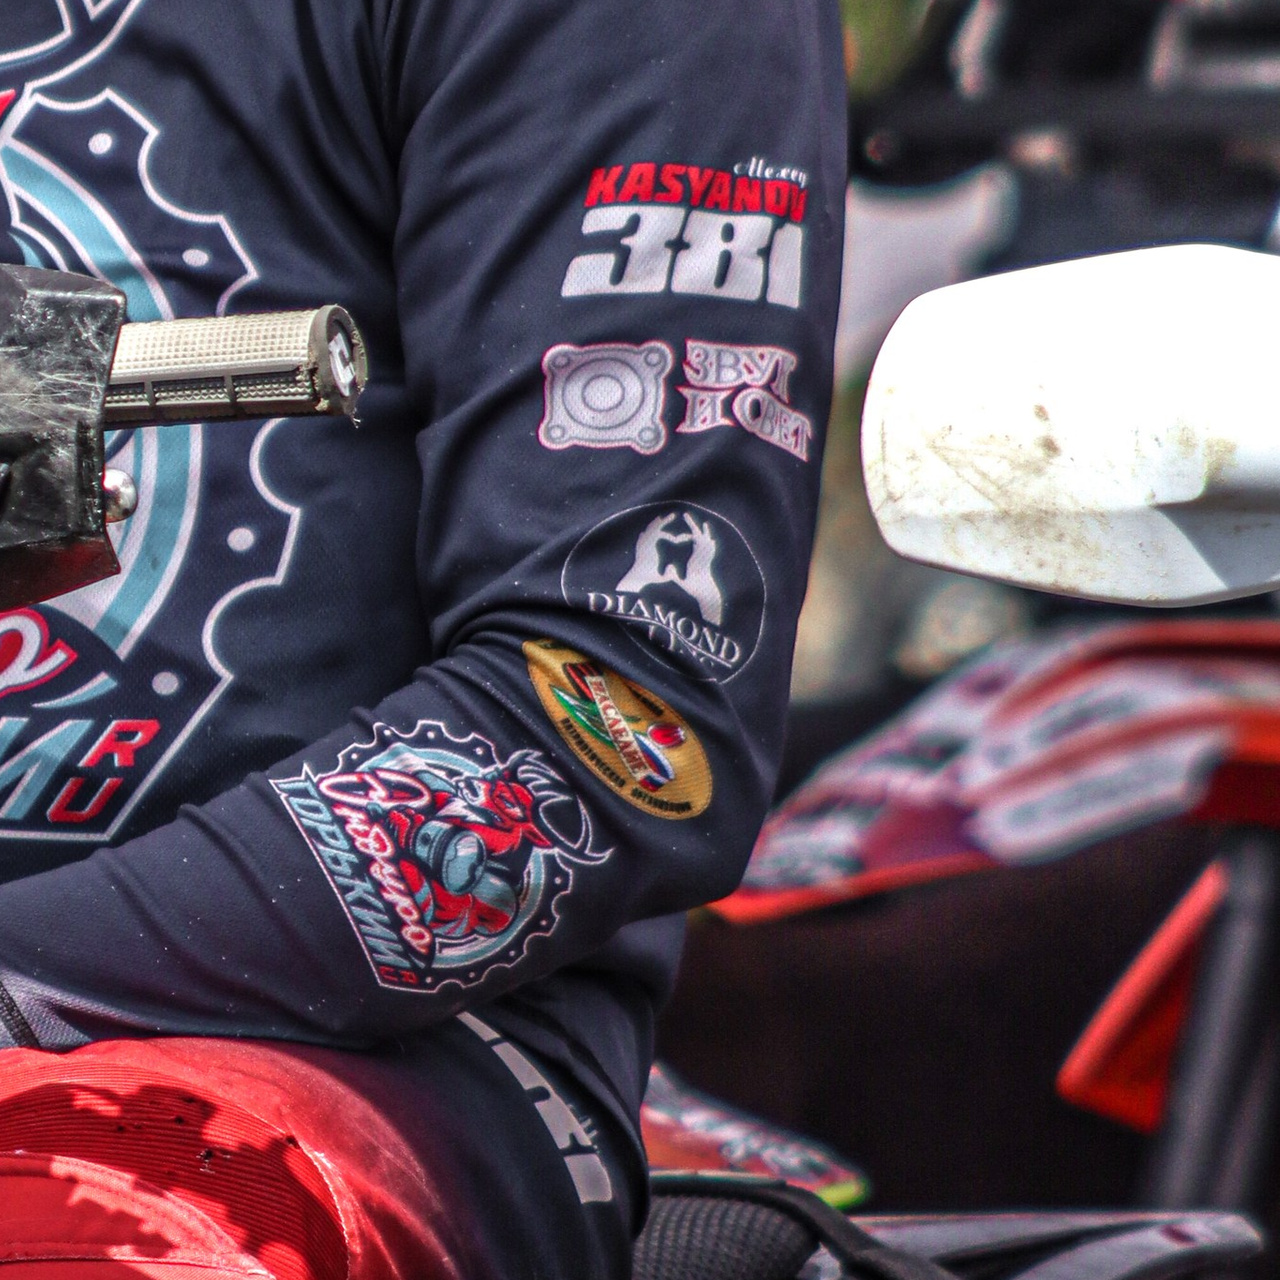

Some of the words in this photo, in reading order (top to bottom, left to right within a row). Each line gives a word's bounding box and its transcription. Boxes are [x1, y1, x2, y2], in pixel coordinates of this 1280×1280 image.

[583, 161, 808, 223] KASYANOV
[561, 204, 803, 309] 381
[587, 591, 742, 665] DIAMOND
